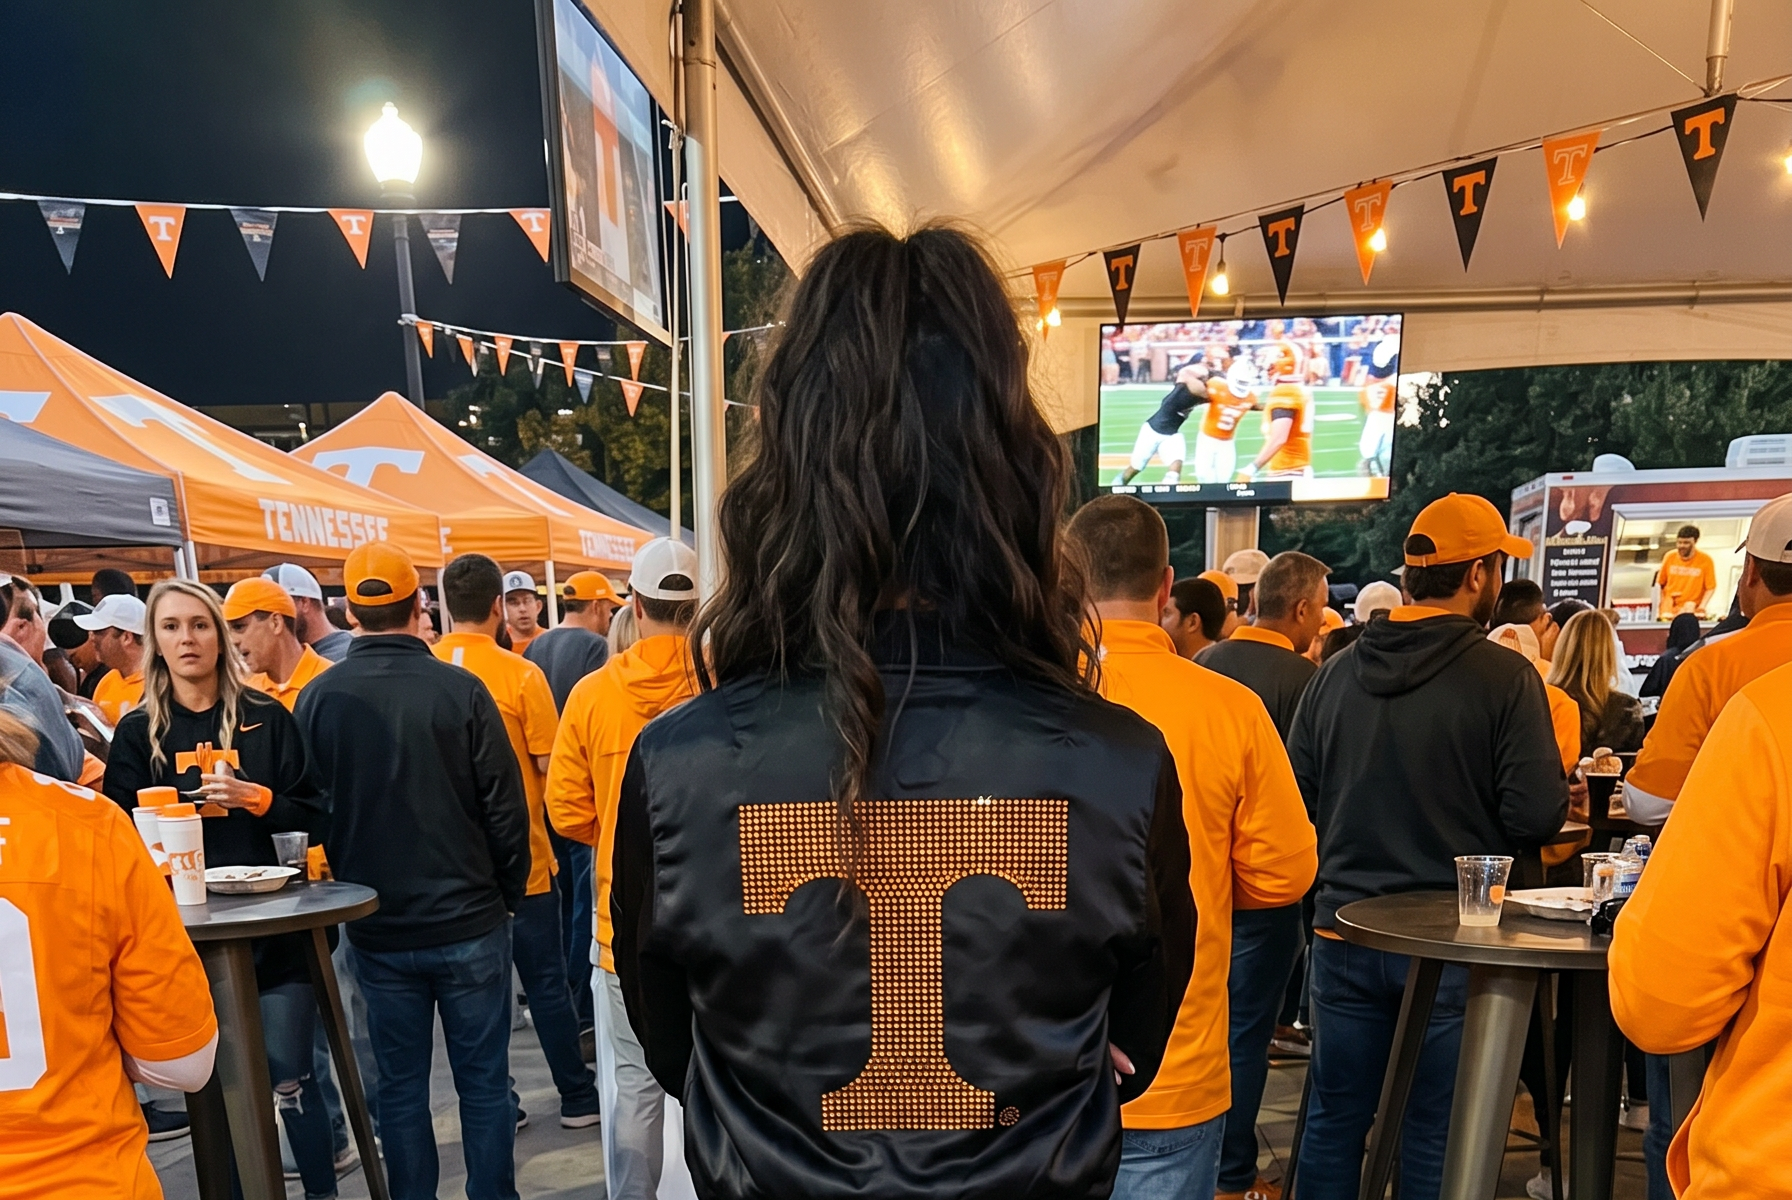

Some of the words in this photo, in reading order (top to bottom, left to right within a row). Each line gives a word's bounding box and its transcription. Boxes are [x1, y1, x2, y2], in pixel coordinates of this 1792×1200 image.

[1685, 107, 1725, 160] T
[1554, 143, 1588, 186] T
[1453, 170, 1486, 216] T
[149, 216, 175, 241] T
[341, 215, 366, 235] T
[521, 213, 545, 232] T
[1355, 192, 1382, 232] T
[1186, 238, 1208, 272] T
[1268, 217, 1295, 258] T
[1038, 272, 1057, 300] T
[1111, 255, 1133, 290] T
[738, 799, 1069, 1131] T
